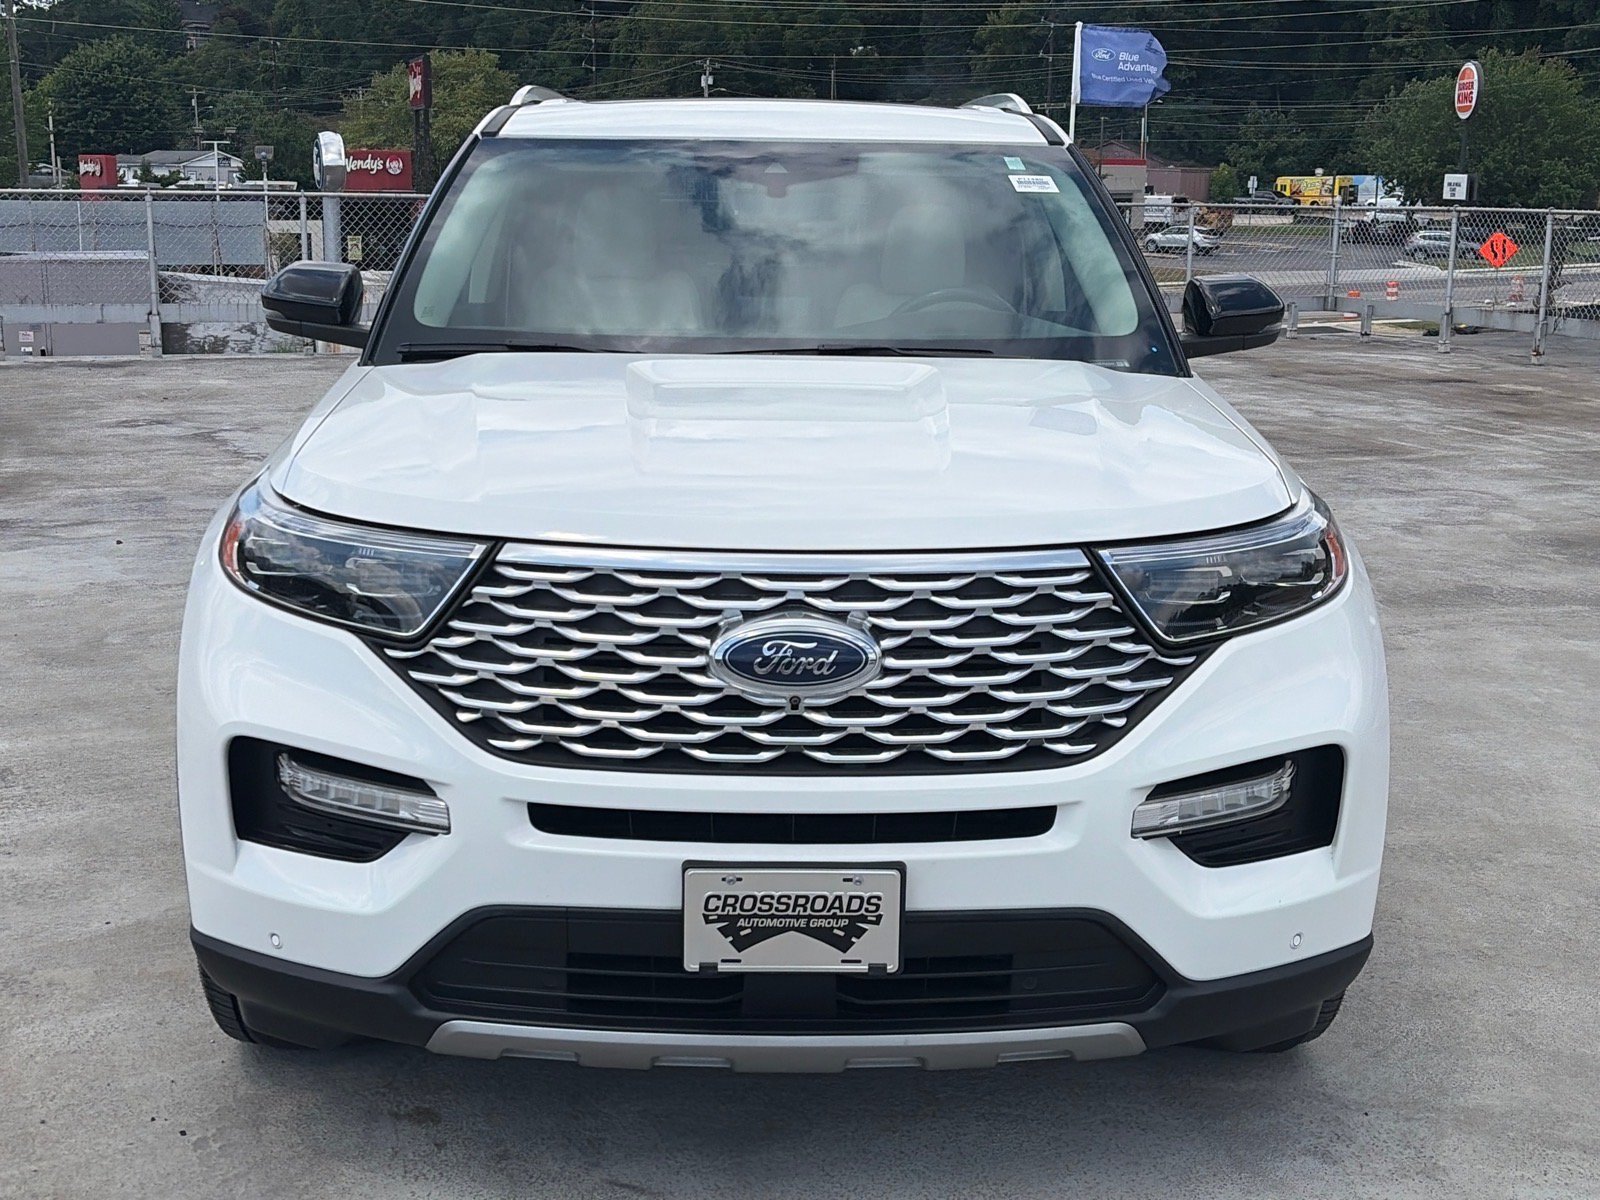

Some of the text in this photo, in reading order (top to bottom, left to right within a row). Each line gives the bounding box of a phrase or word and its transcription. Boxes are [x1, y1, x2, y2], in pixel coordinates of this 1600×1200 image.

[1119, 52, 1140, 61] Blue
[1457, 91, 1473, 104] KING
[753, 639, 839, 676] Ford
[703, 893, 883, 914] CROSSROADS
[736, 917, 849, 928] AUTOMOTIVE GROUP
